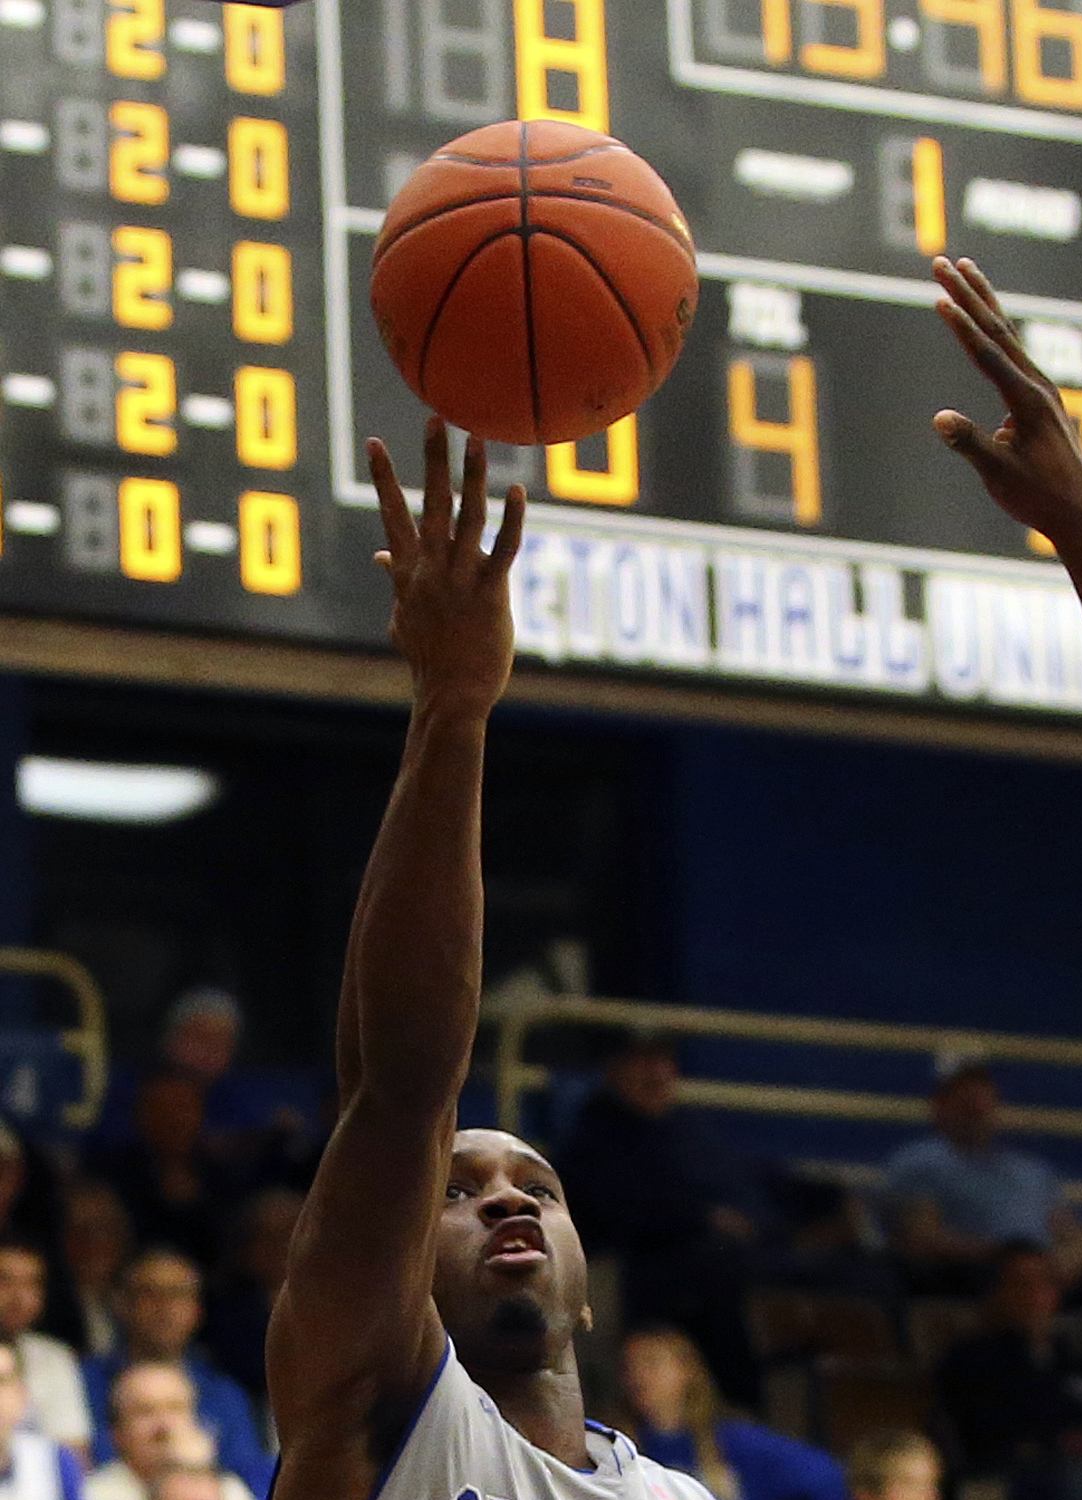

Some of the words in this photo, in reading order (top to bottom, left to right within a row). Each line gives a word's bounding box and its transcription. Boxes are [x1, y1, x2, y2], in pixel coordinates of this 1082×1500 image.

[728, 354, 822, 526] 4
[512, 528, 708, 670] ETON
[710, 548, 927, 697] HALL
